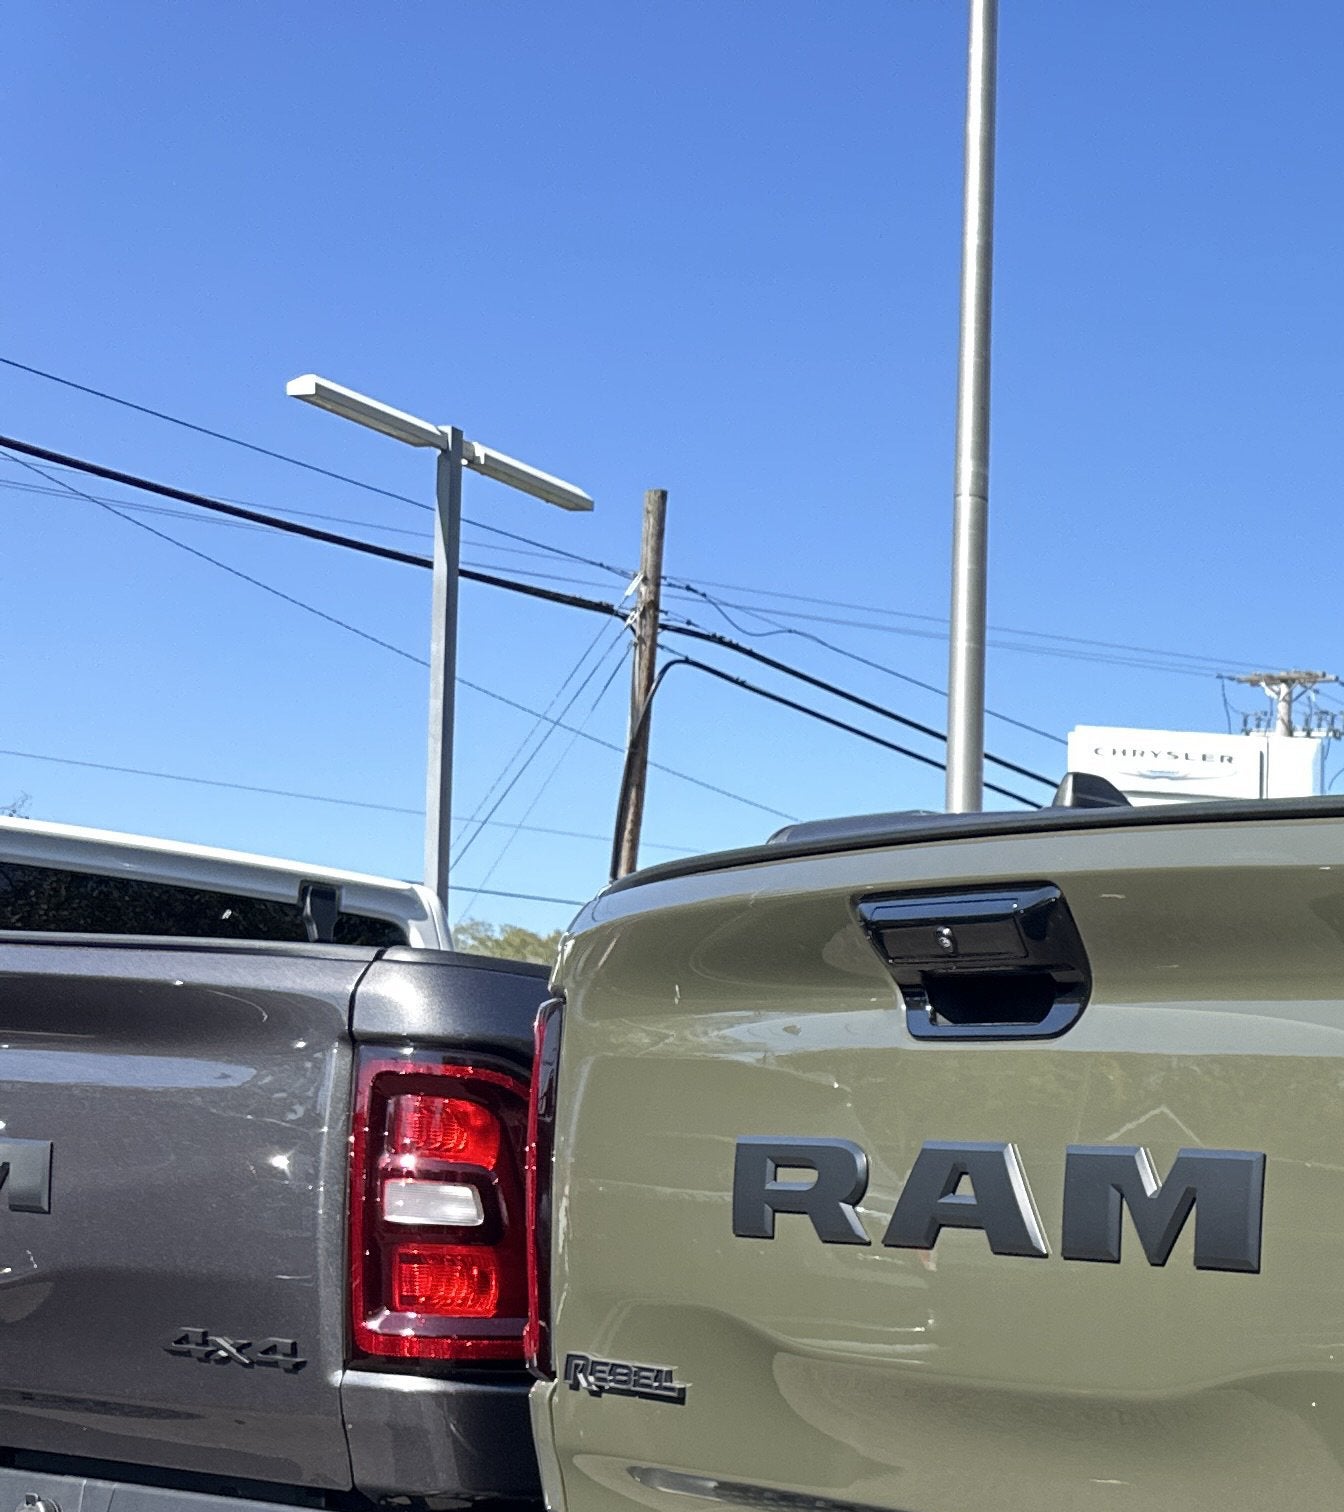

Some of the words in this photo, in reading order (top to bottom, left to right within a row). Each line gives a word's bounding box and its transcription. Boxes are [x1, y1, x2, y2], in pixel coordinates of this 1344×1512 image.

[1094, 747, 1233, 764] CHRYSLER
[732, 1135, 1266, 1274] RAM
[563, 1351, 688, 1406] REBEL
